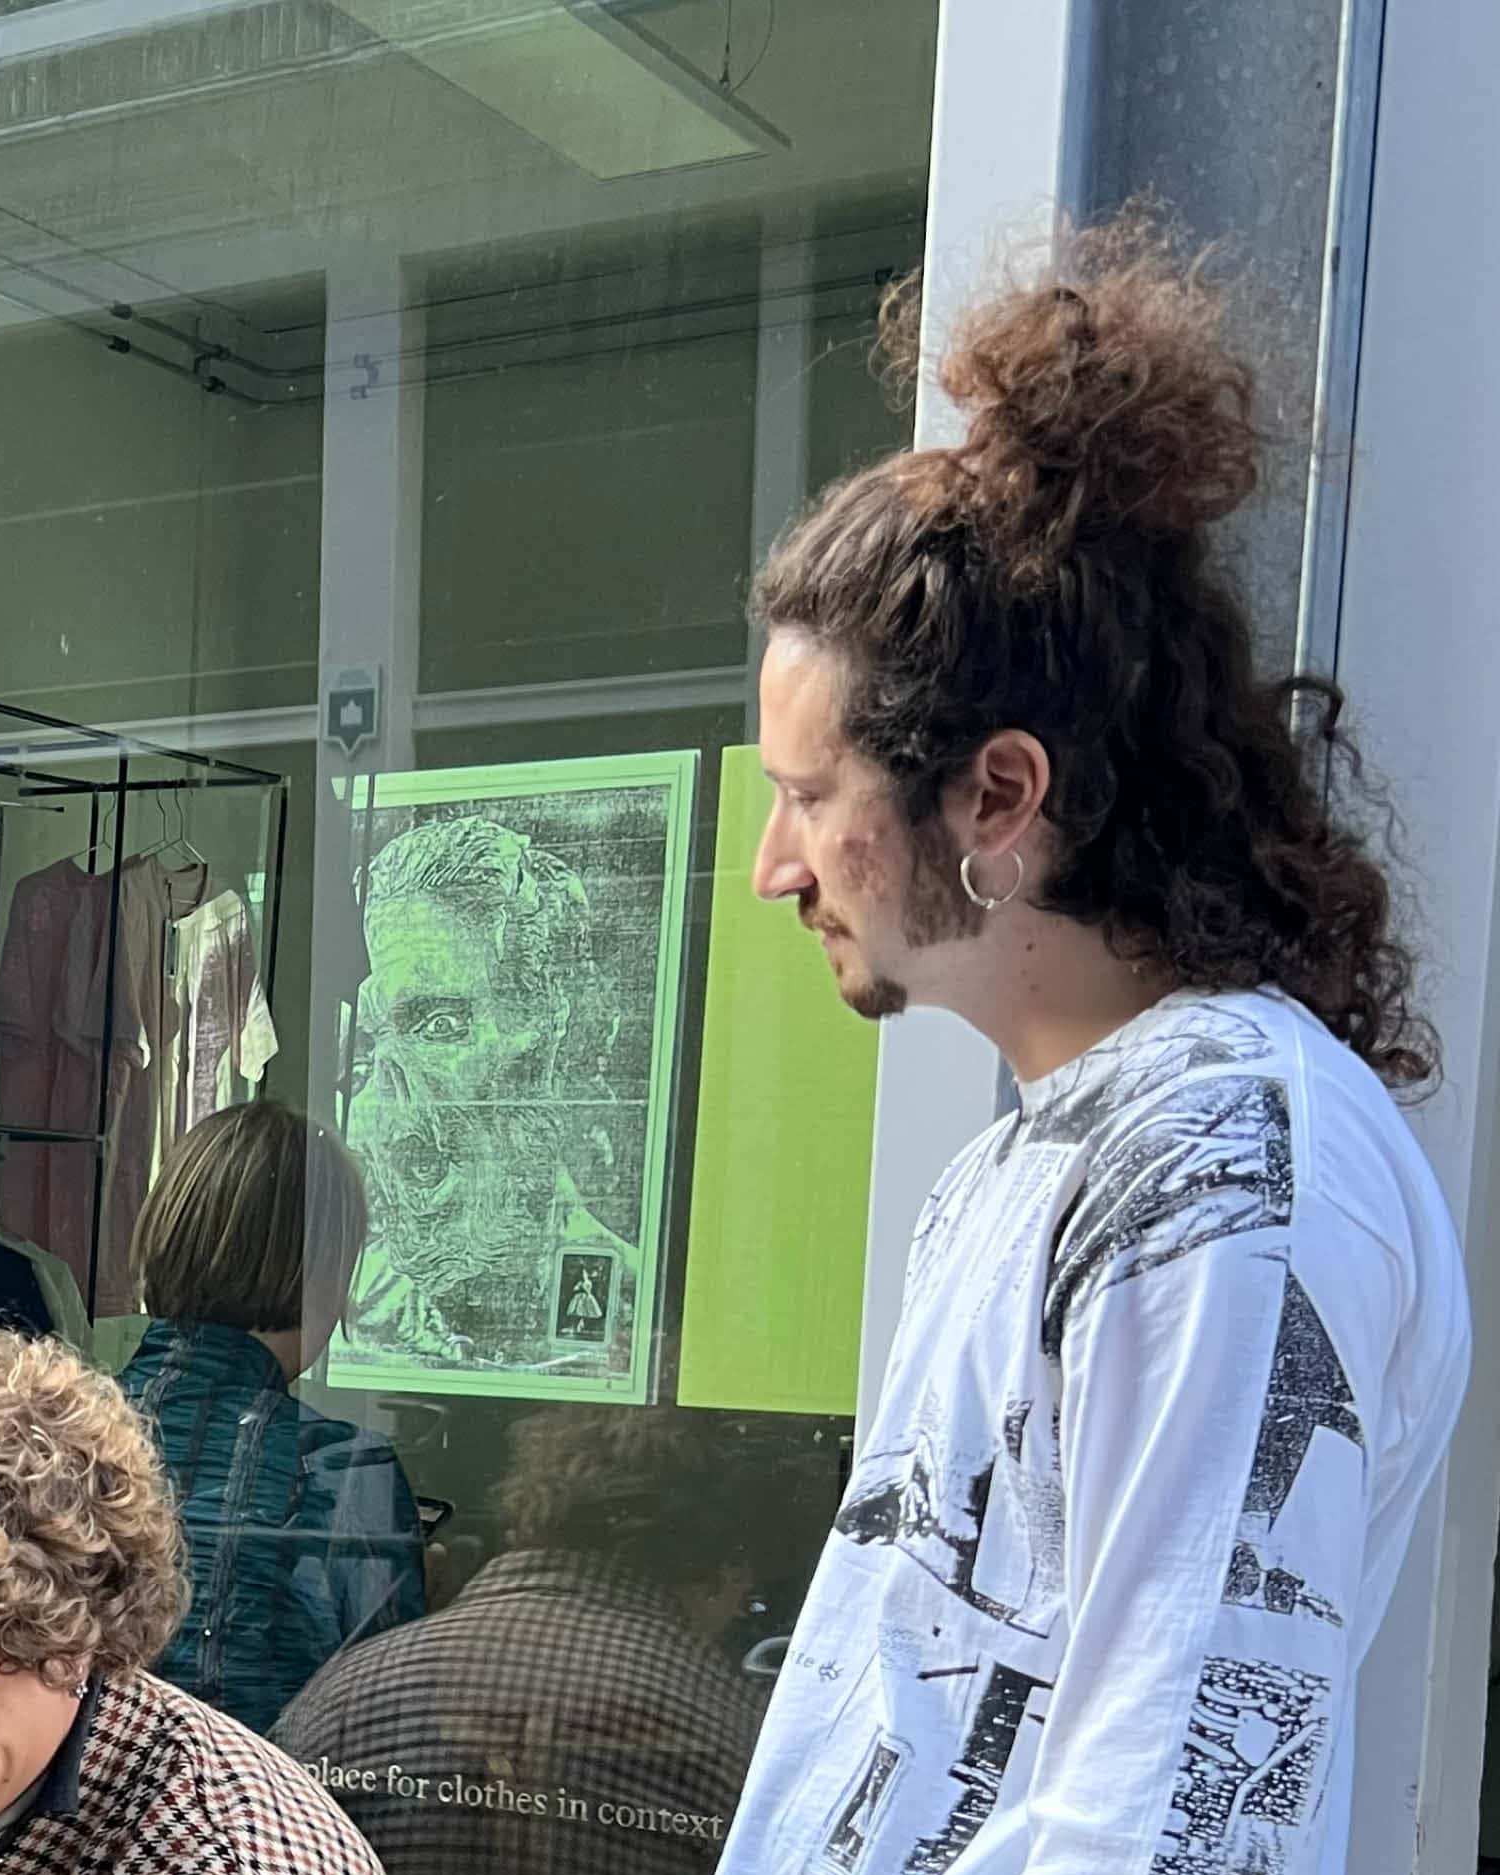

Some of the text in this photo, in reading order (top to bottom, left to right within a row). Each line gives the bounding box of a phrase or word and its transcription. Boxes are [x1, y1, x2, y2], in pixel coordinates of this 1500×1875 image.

[385, 1764, 430, 1799] for
[437, 1774, 548, 1817] clothes
[557, 1790, 588, 1823] in
[596, 1801, 724, 1841] context
